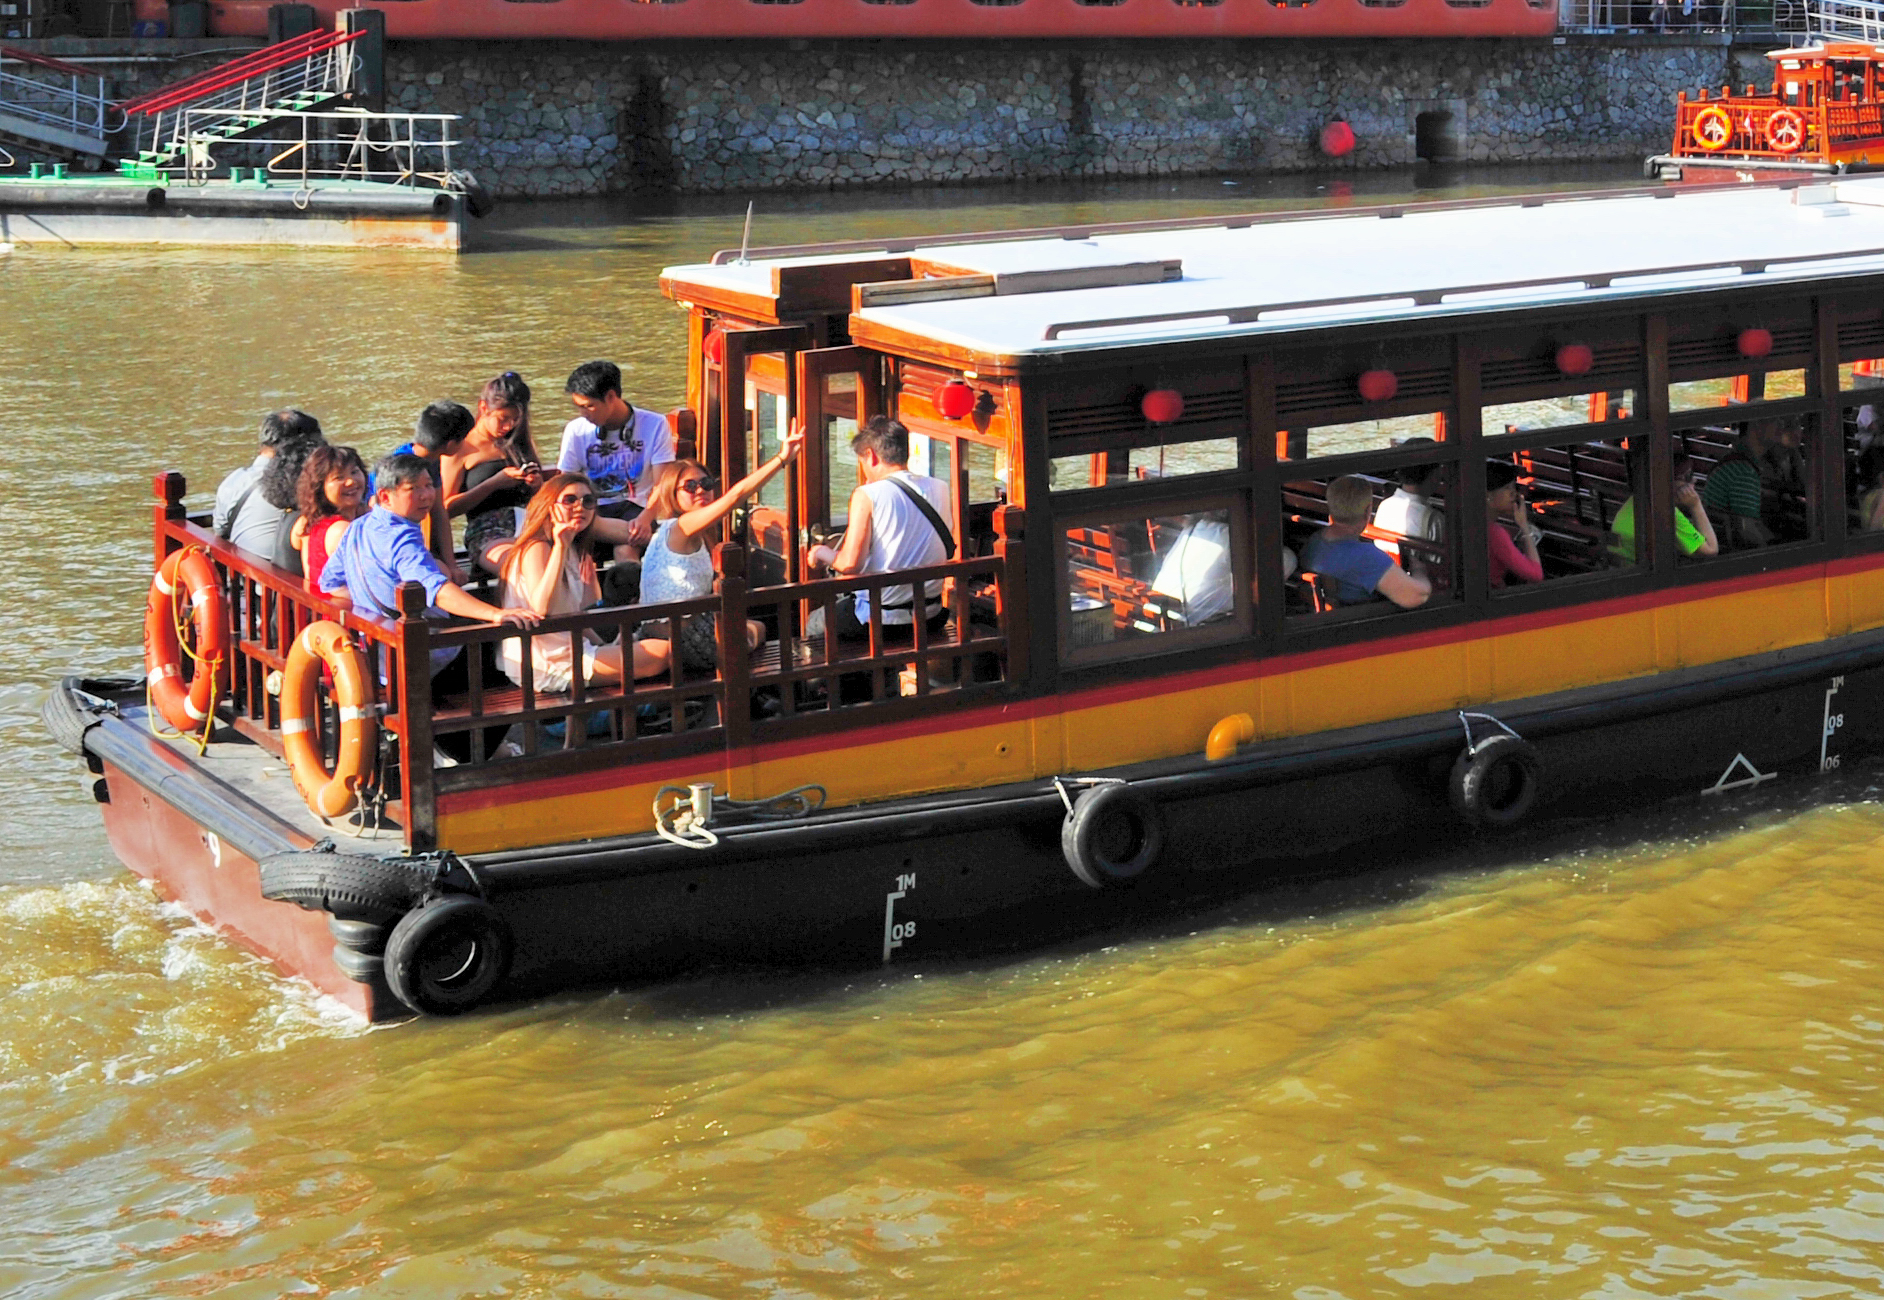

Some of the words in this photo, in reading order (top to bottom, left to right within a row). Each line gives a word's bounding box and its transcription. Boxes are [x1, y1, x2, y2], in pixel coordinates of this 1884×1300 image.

[1828, 713, 1844, 729] 08
[1824, 754, 1841, 770] 06
[207, 831, 221, 869] 9
[895, 872, 917, 892] 1M
[892, 921, 917, 941] 08
